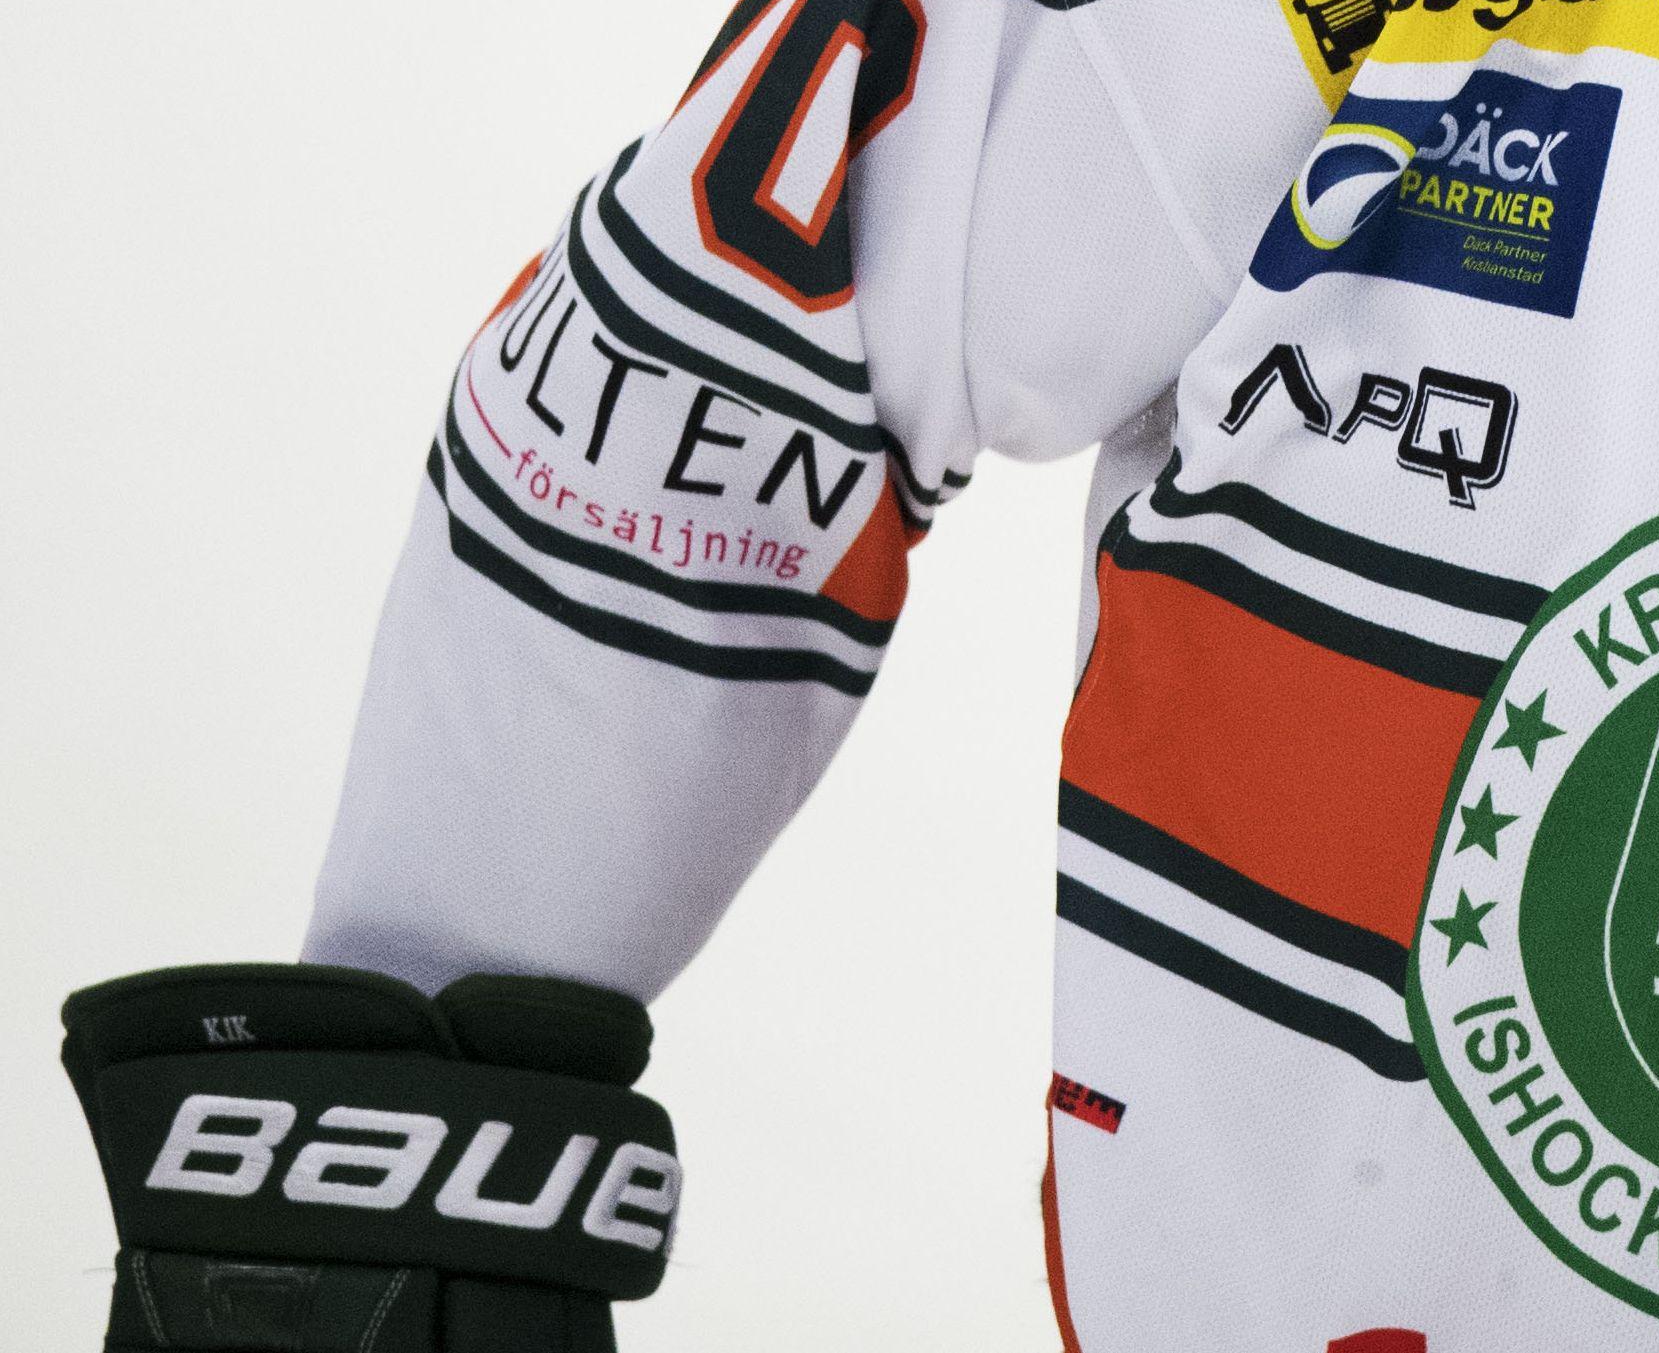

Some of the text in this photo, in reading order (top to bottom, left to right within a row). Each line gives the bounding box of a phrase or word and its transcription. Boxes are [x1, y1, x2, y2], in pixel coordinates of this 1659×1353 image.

[1400, 169, 1555, 231] PARTNER
[1494, 240, 1548, 263] Partner
[497, 240, 867, 531] ULTEN
[514, 448, 810, 581] försäljning
[201, 1014, 257, 1043] KIK
